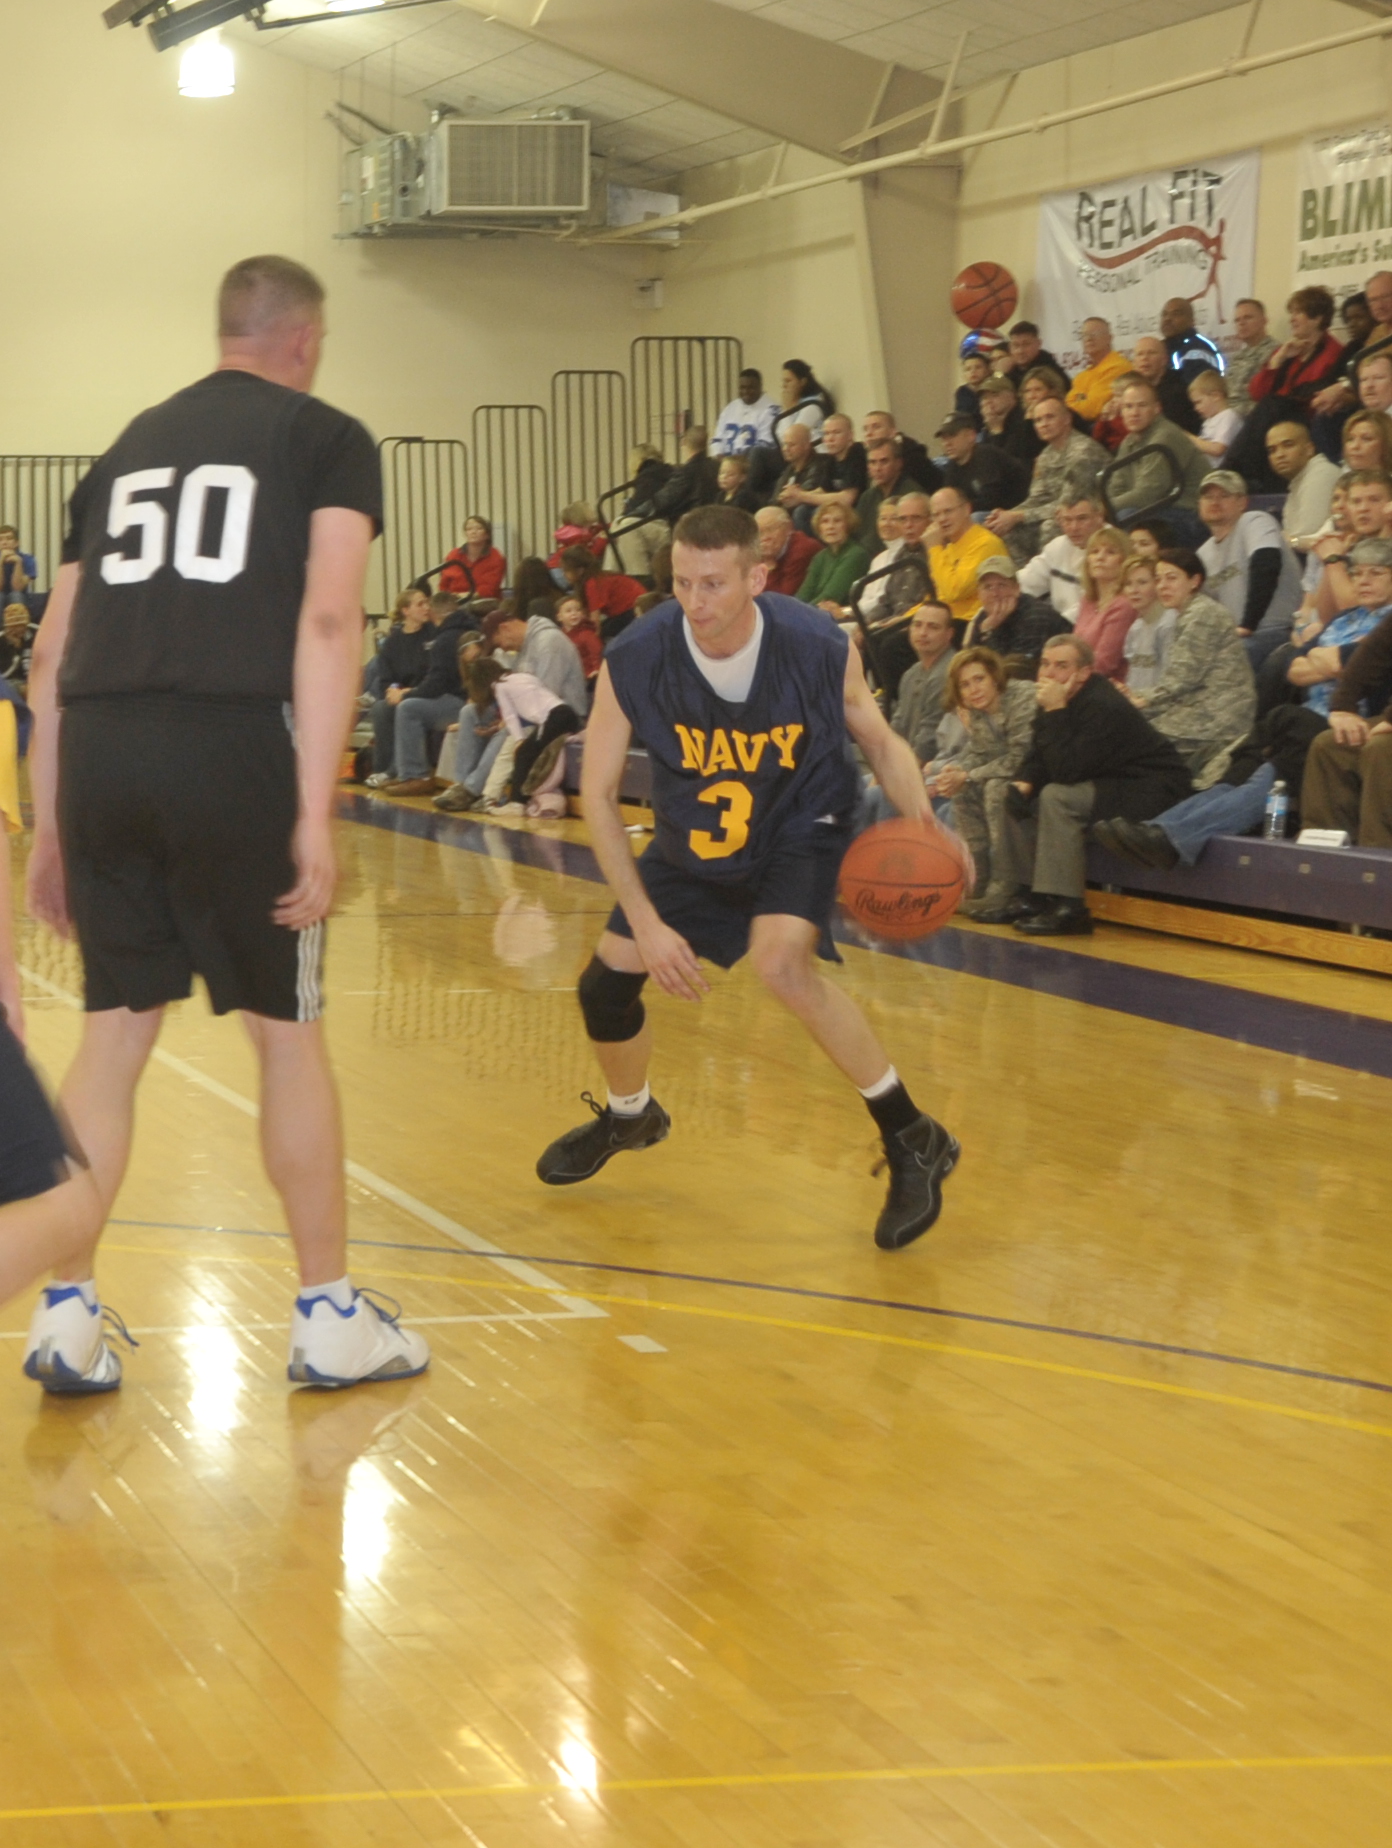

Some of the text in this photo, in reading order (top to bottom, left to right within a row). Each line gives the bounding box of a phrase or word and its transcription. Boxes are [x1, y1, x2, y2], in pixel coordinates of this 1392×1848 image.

[1075, 168, 1223, 249] REAL FIT
[1299, 175, 1392, 241] BLIM
[100, 463, 258, 585] 50
[674, 723, 804, 776] NAVY
[688, 780, 754, 860] 3
